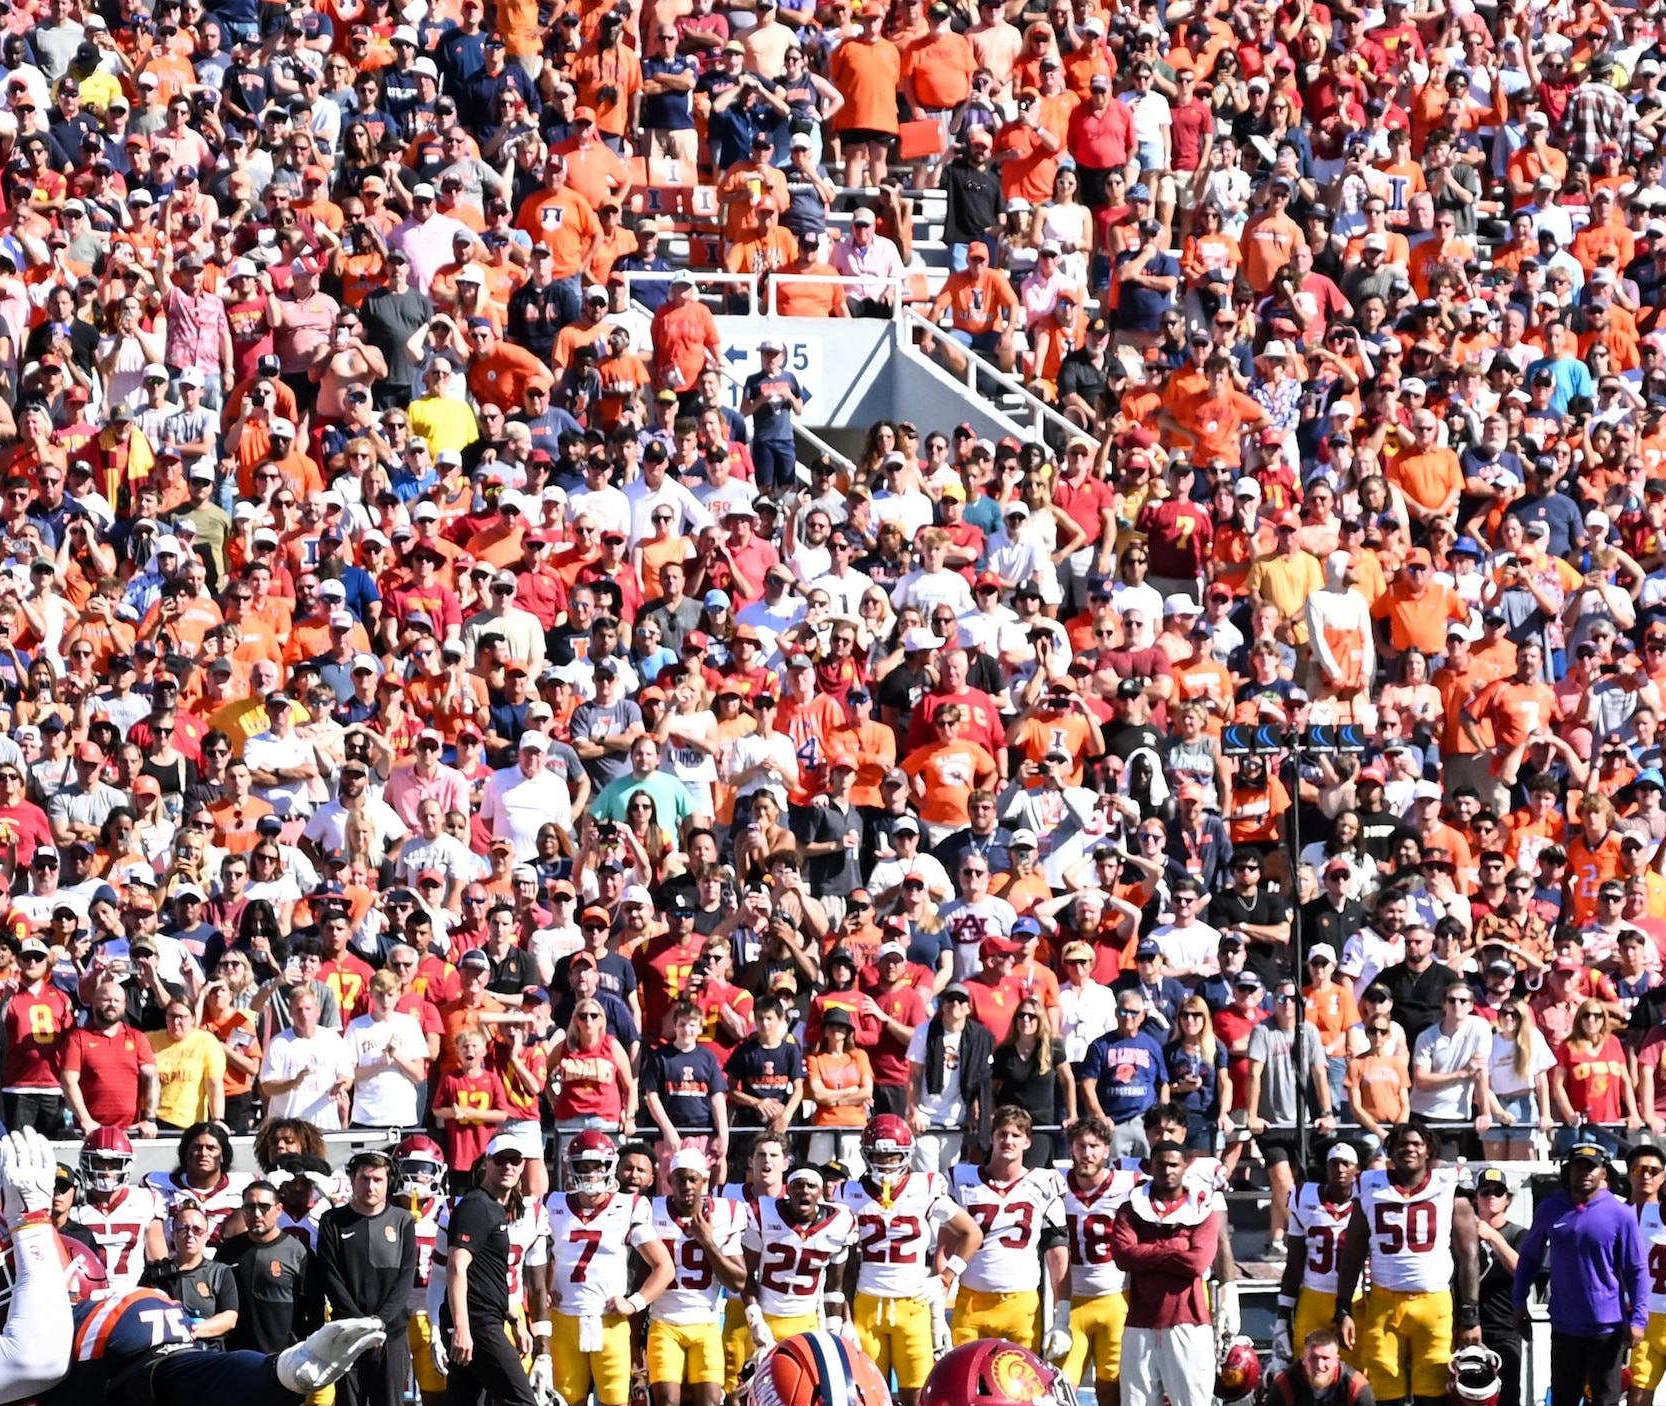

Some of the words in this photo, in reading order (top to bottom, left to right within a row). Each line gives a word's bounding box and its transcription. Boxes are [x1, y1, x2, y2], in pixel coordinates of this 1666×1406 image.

[29, 1003, 56, 1043] 8
[858, 1213, 918, 1264] 22
[967, 1201, 1036, 1251] 73
[1068, 1213, 1112, 1266] 18
[1374, 1202, 1438, 1256] 50
[567, 1229, 602, 1284] 7
[761, 1242, 831, 1296] 25
[138, 1308, 193, 1347] 75
